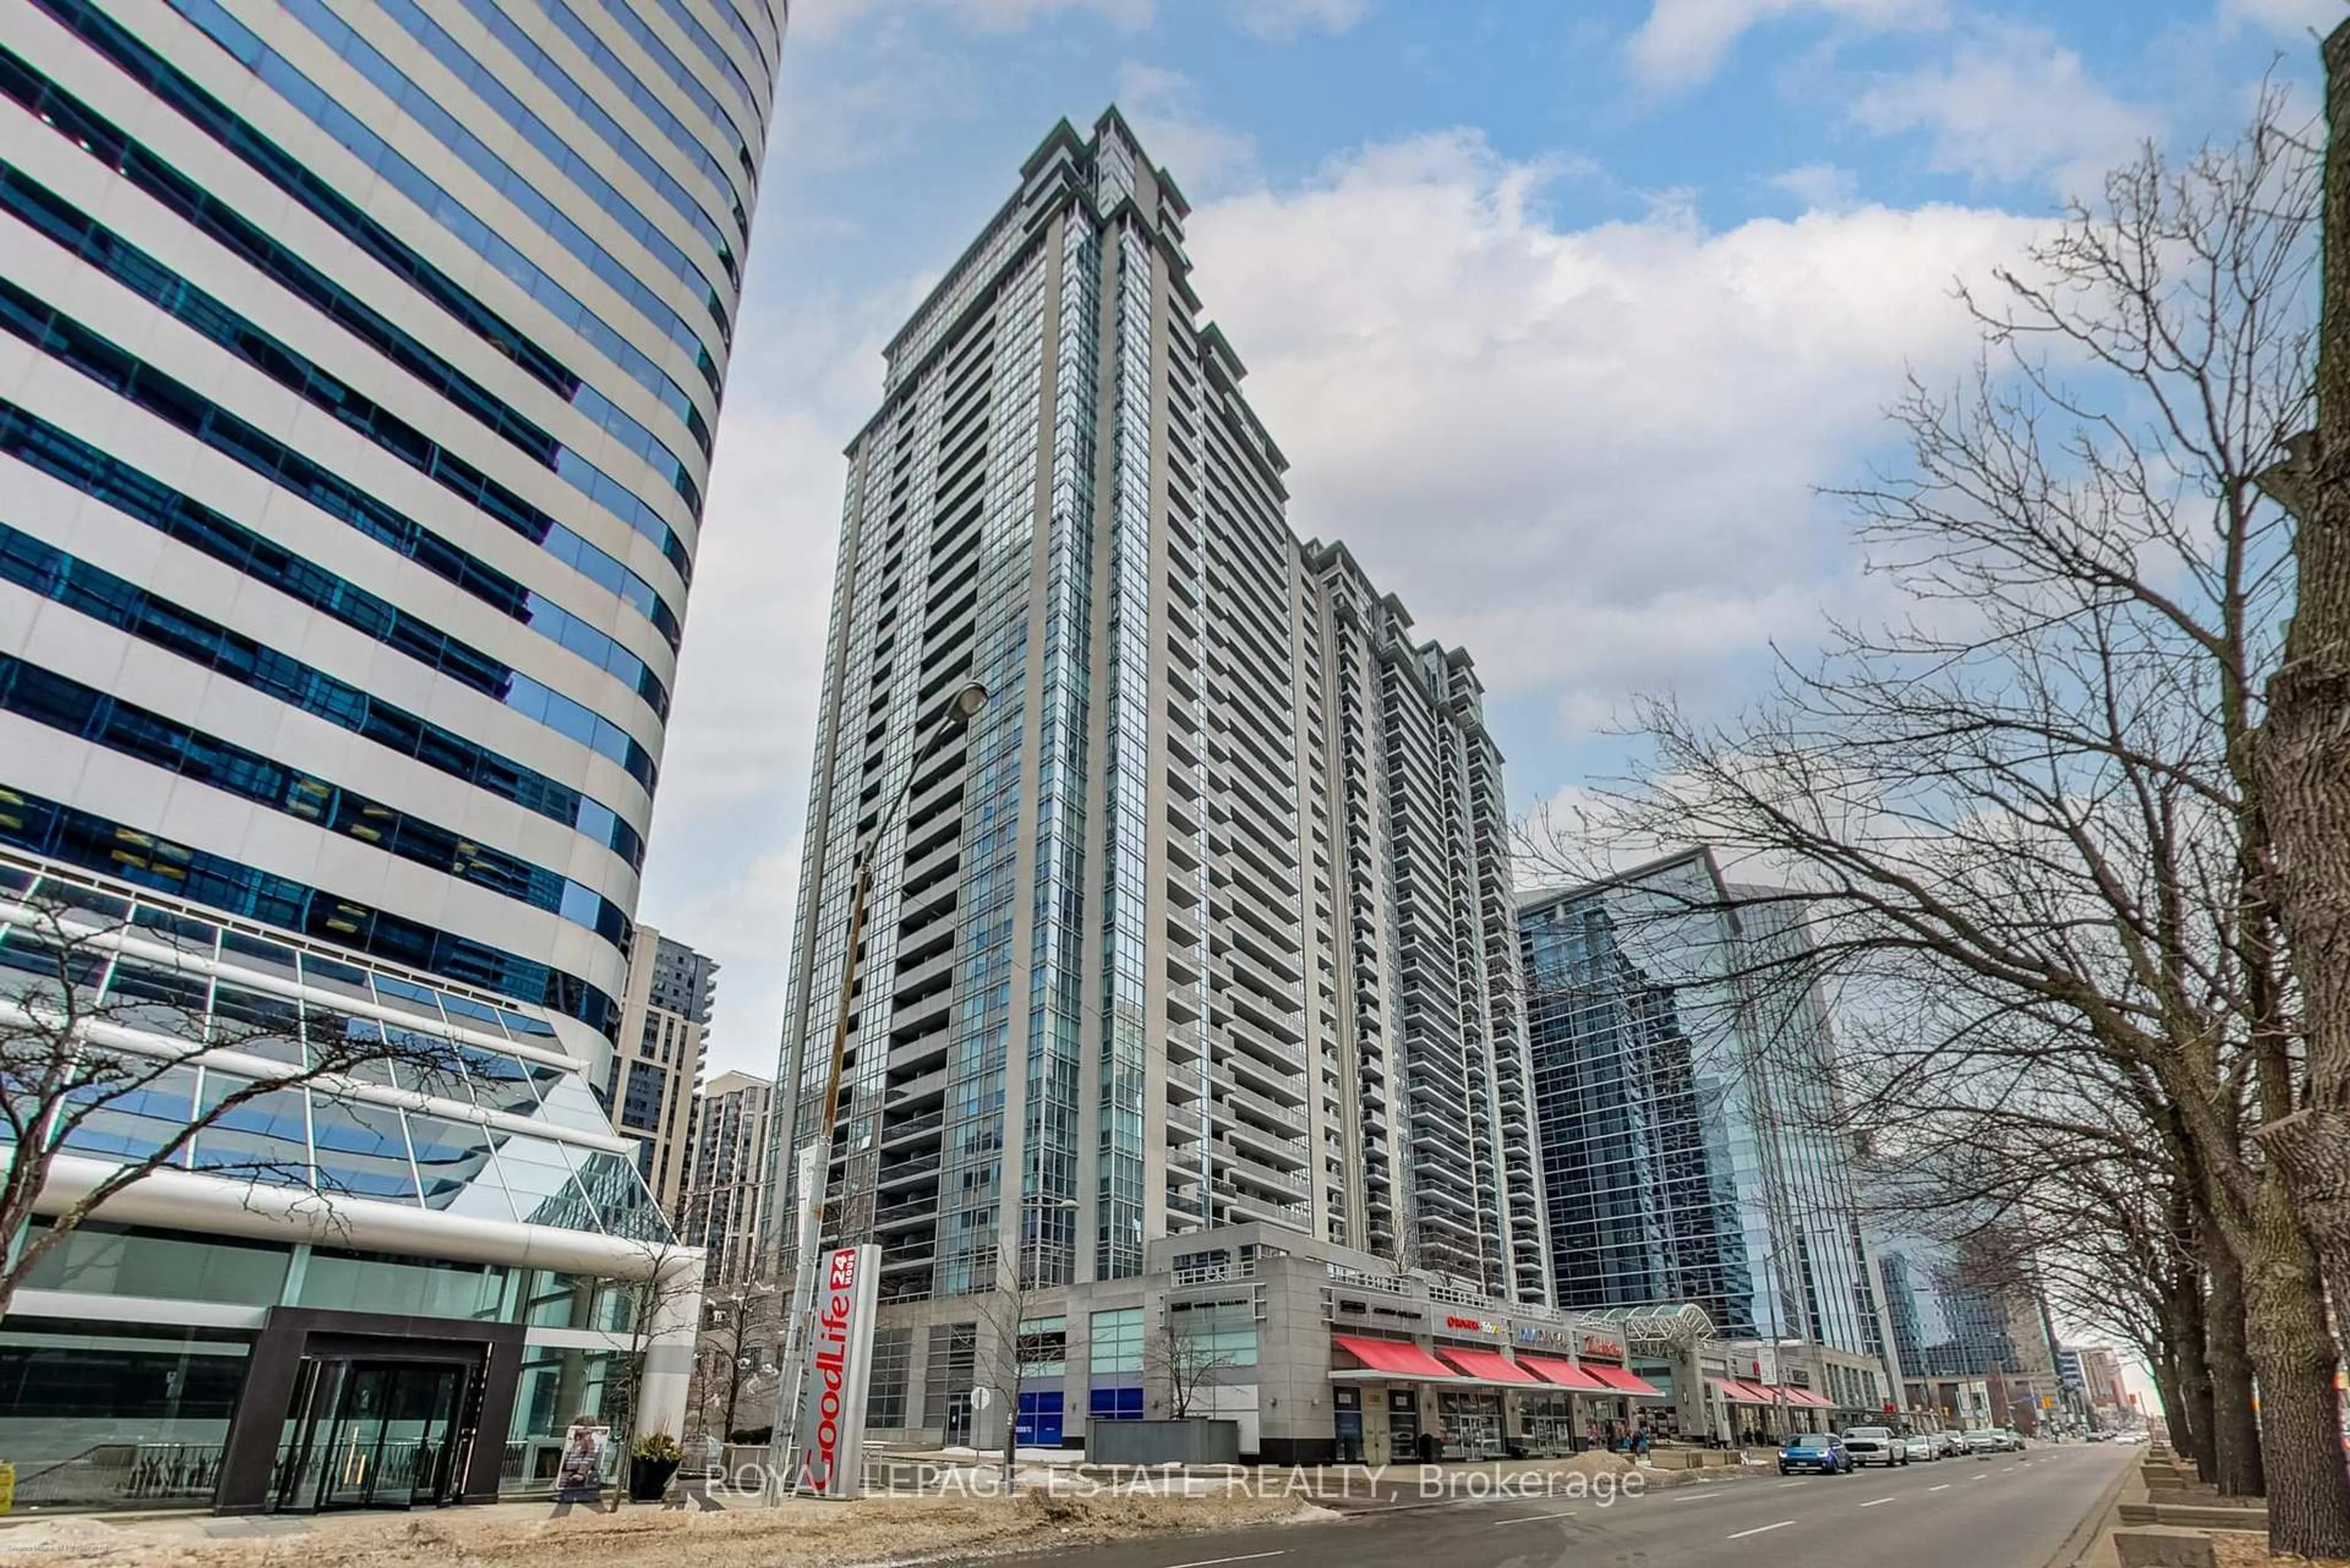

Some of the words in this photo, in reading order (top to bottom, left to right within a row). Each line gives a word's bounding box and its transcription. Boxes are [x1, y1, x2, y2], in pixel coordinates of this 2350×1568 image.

[832, 1254, 847, 1285] 24
[845, 1253, 855, 1286] HOUR
[807, 1294, 850, 1491] GoodLife
